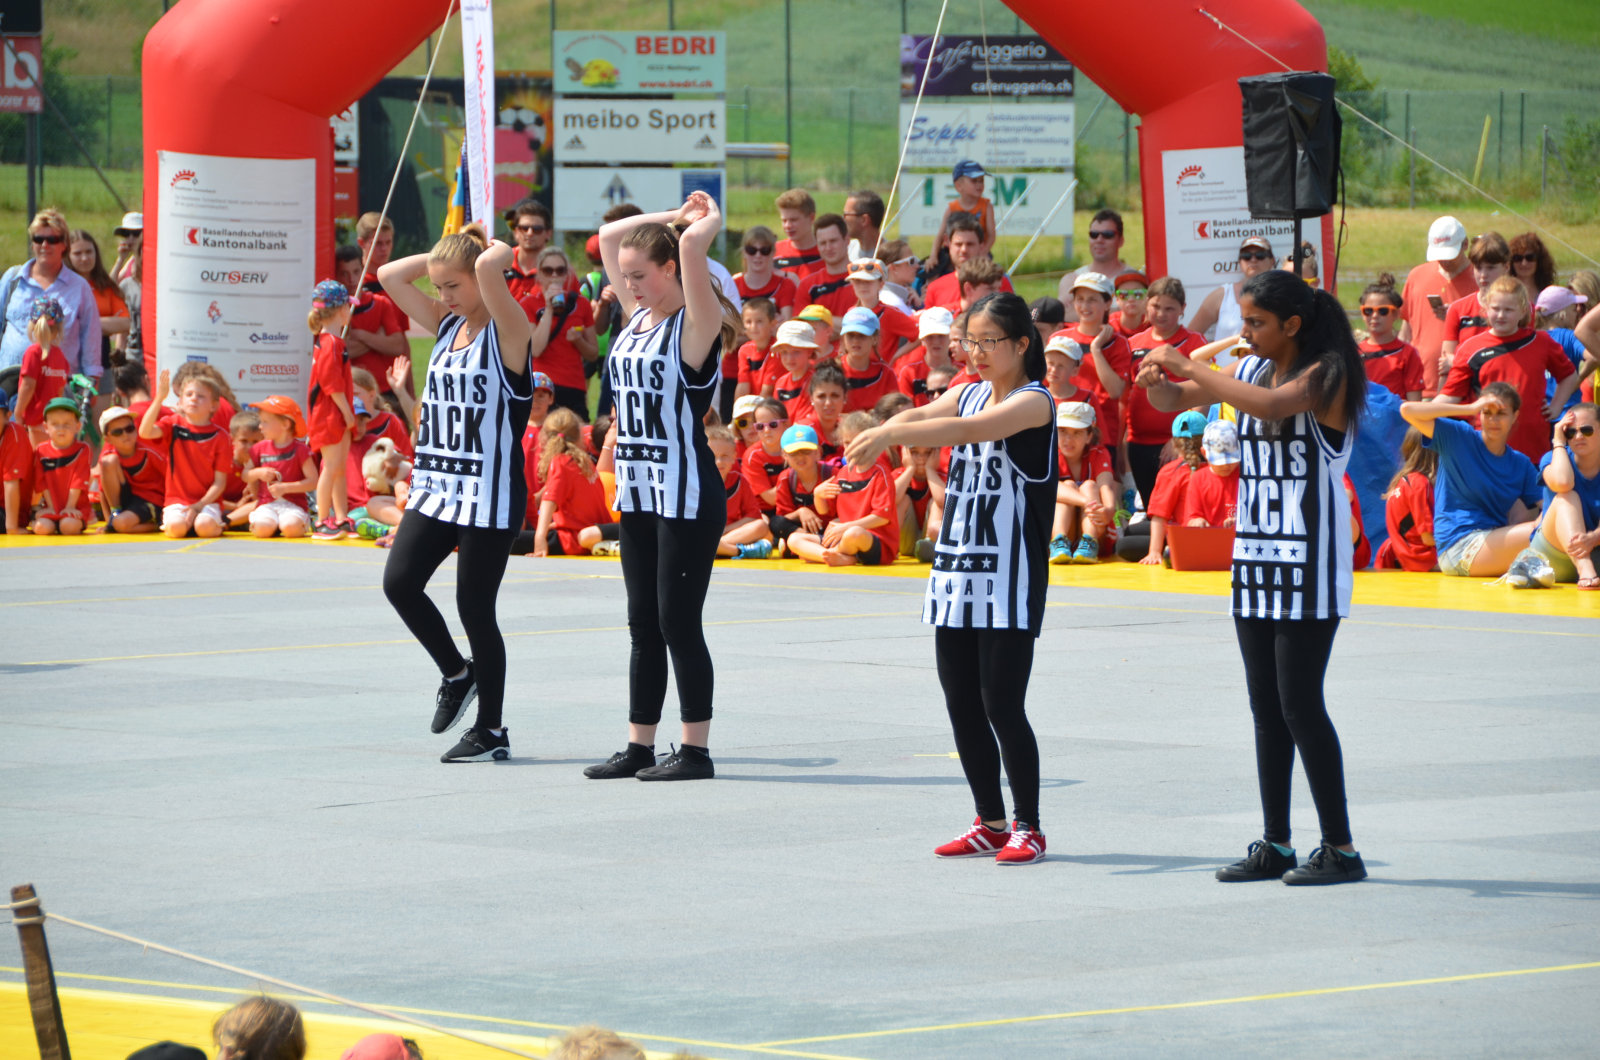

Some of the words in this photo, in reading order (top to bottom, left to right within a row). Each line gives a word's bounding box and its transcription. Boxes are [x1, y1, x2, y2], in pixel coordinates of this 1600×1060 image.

[635, 36, 716, 55] BEDRI
[971, 41, 1047, 62] ruggerio
[638, 79, 714, 89] www.bedri.ch
[971, 79, 1073, 95] caferuggerio.ch
[563, 109, 639, 129] meibo
[648, 108, 717, 134] Sport
[905, 116, 980, 145] Seppi
[202, 227, 288, 239] Basellandschaftliche
[202, 237, 288, 251] Kantonalbank
[200, 270, 269, 284] OUTSERV
[261, 332, 290, 341] Basler
[249, 363, 300, 376] SWISSLOS
[611, 389, 669, 441] LCK
[416, 402, 487, 454] BLCK
[1237, 439, 1308, 477] ARIS
[1234, 478, 1308, 536] BLCK
